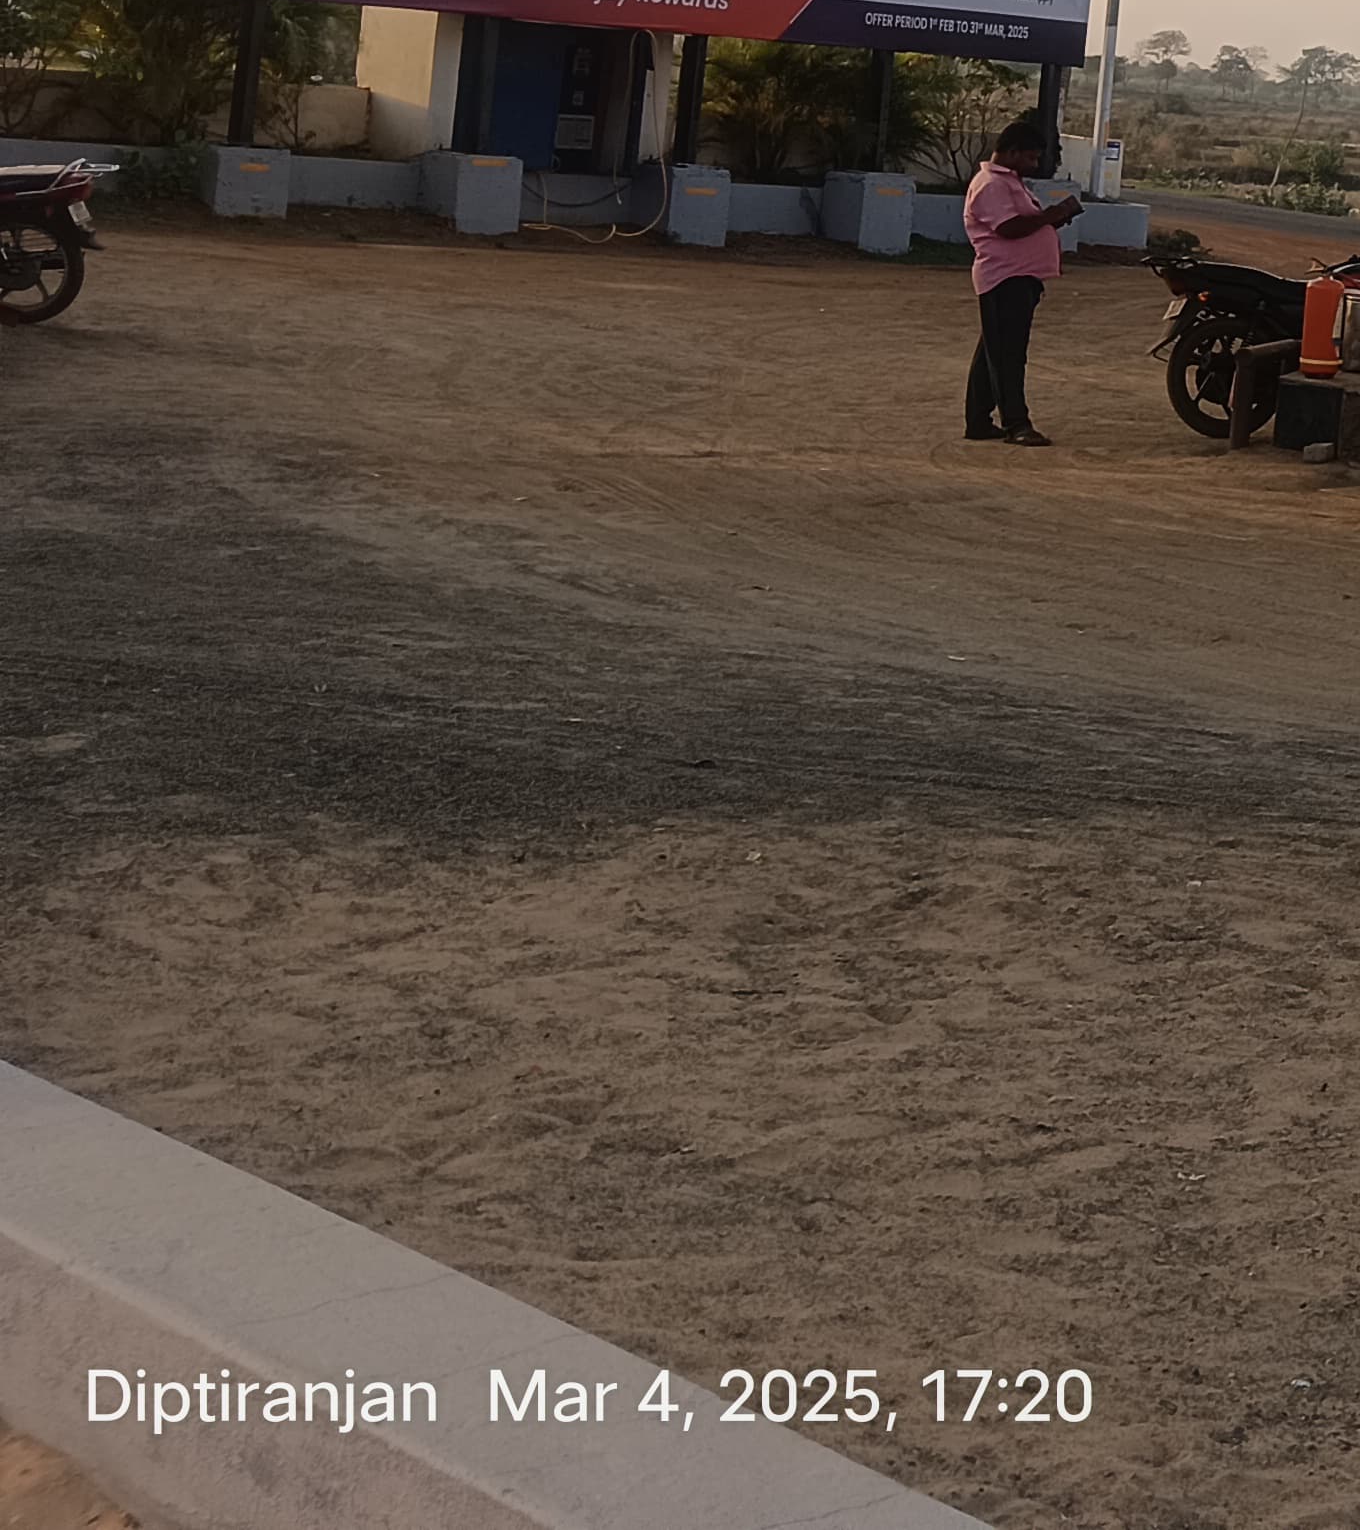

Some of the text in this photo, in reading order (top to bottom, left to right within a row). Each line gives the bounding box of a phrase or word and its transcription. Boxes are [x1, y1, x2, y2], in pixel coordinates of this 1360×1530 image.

[865, 11, 1030, 39] OFFER PERIOD 1st FEB TO 31st MAR, 2025
